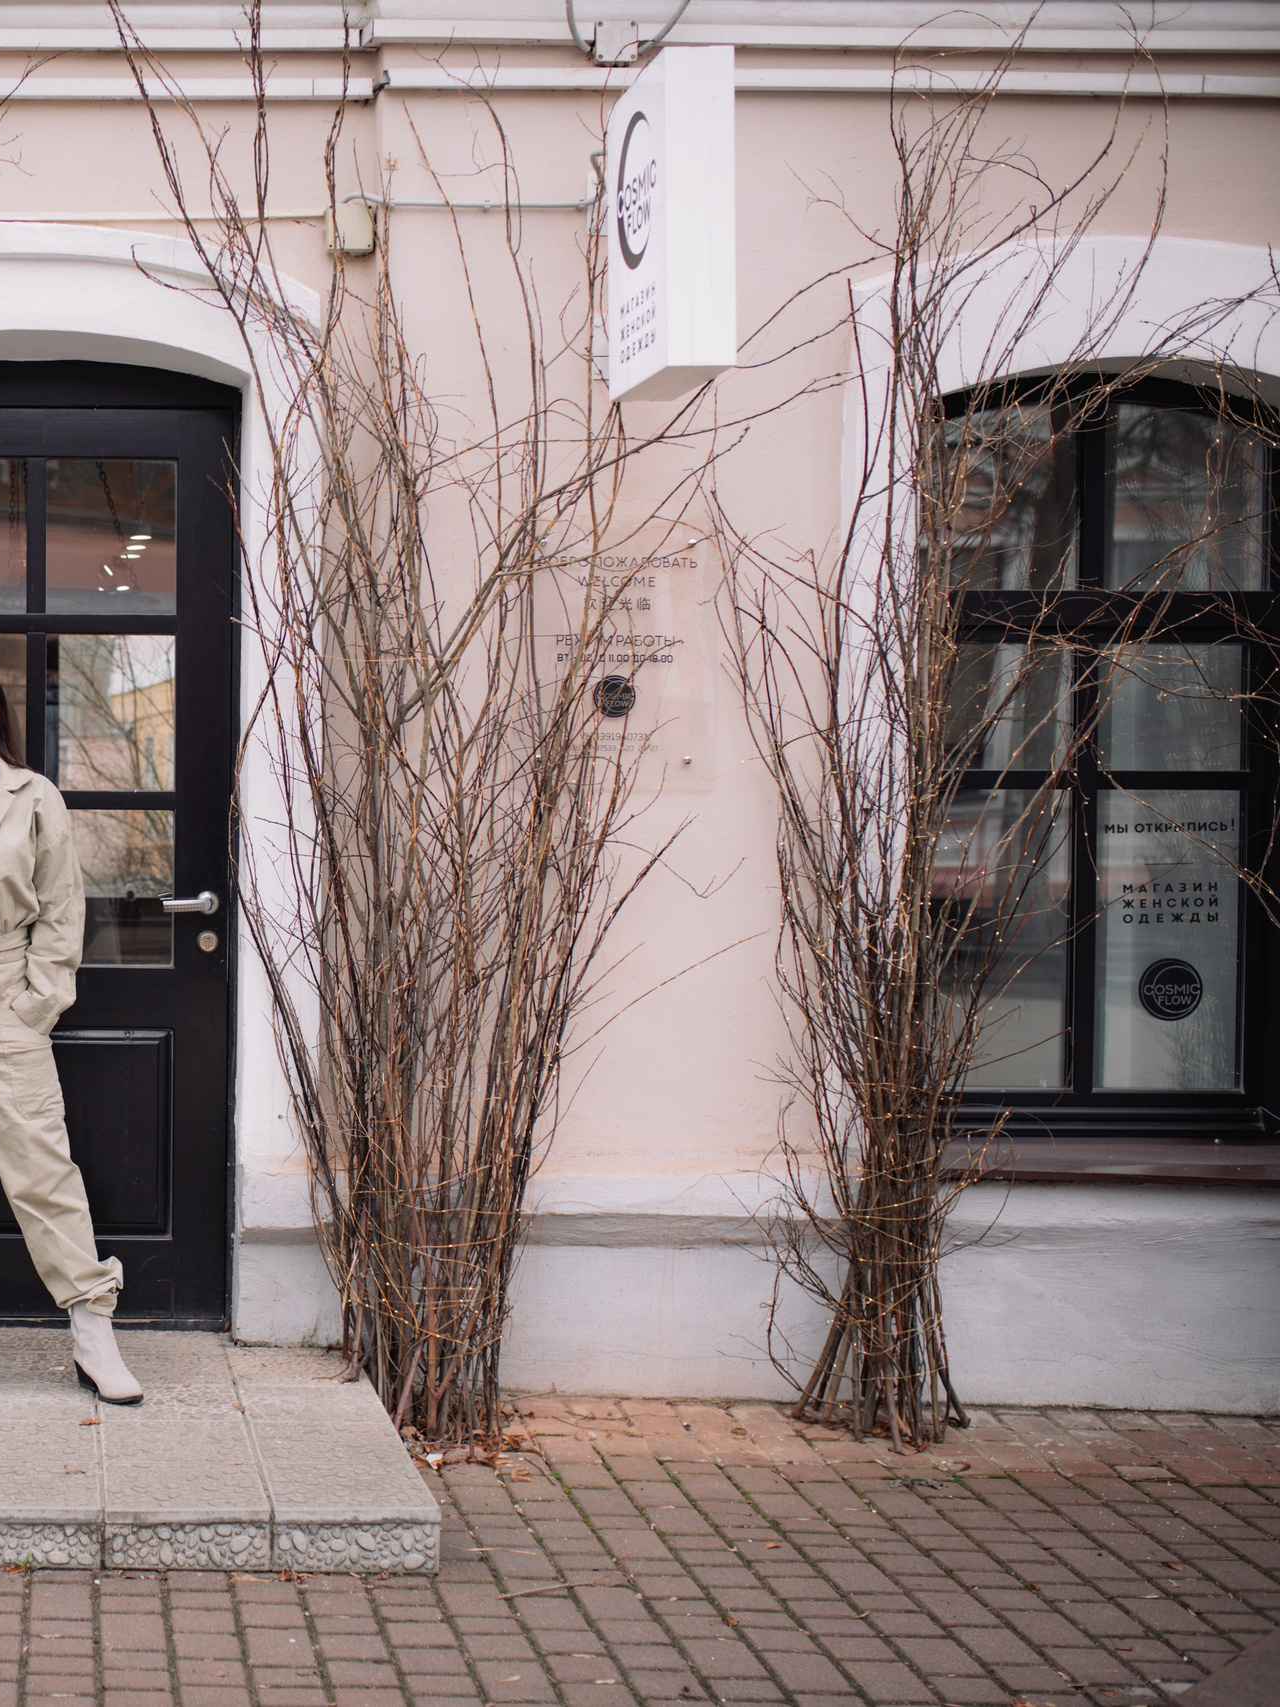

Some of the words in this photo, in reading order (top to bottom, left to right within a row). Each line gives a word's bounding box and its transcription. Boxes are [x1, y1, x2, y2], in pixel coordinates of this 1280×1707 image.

[617, 159, 657, 218] COSMIC
[626, 196, 652, 240] FLOW
[620, 281, 656, 319] МАГАЗИН
[620, 301, 656, 342] ЖЕНСКОЙ
[620, 328, 656, 364] ОДЕЖДЫ
[578, 576, 656, 587] WELCOME
[616, 635, 675, 647] РАБОТЫ
[1104, 824, 1128, 833] МЫ
[1122, 882, 1219, 893] МАГАЗИН
[1122, 895, 1219, 908] ЖЕНСКОЙ
[1123, 912, 1219, 924] ОДЕЖДЫ
[1144, 984, 1200, 995] COSMIC
[1158, 996, 1192, 1005] FLOW
